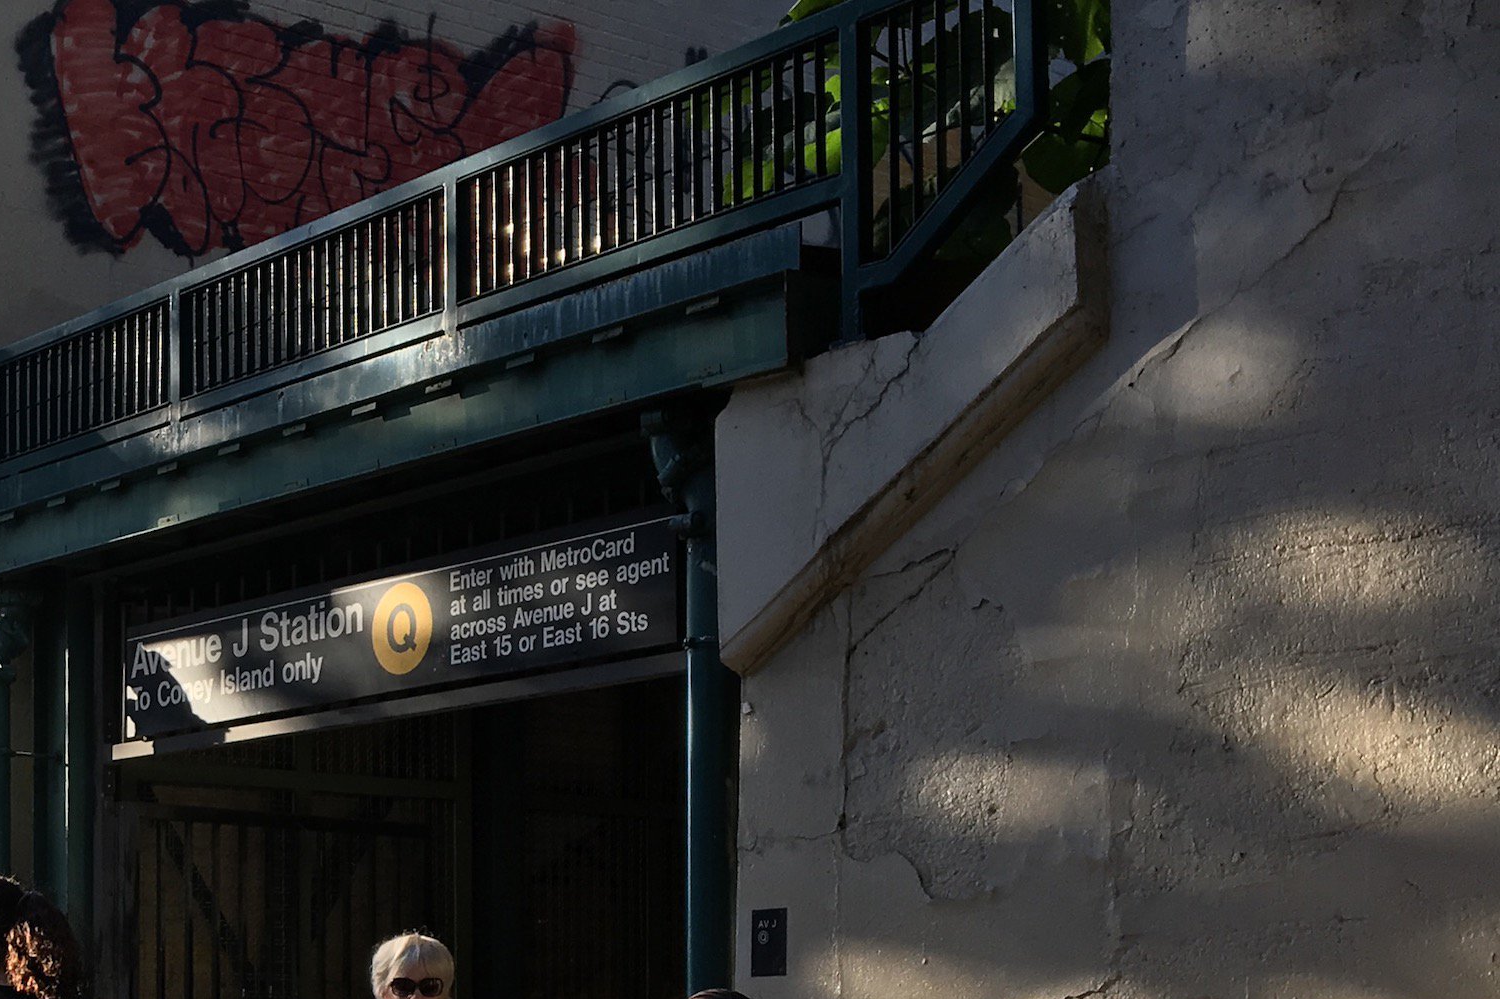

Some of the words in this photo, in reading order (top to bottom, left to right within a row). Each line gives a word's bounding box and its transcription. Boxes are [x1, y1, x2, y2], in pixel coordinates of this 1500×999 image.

[450, 567, 493, 592] Enter
[500, 555, 534, 581] with
[541, 532, 635, 573] MetroCard
[450, 595, 466, 616] at
[473, 589, 491, 612] all
[497, 582, 544, 607] times
[550, 576, 569, 596] or
[575, 568, 610, 591] see
[616, 552, 670, 585] agent
[131, 634, 222, 679] Avenue
[233, 618, 249, 658] J
[260, 601, 364, 652] Station
[387, 604, 417, 653] Q
[450, 615, 507, 641] across
[513, 601, 575, 629] Avenue
[581, 593, 592, 616] J
[599, 589, 617, 612] at
[450, 640, 487, 665] East
[493, 634, 512, 657] 15
[518, 634, 537, 653] or
[543, 621, 582, 648] East
[589, 615, 610, 640] 16
[616, 611, 649, 635] Sts
[133, 687, 151, 712] To
[157, 676, 214, 707] Coney
[220, 659, 275, 696] Island
[282, 652, 323, 684] only
[772, 919, 777, 928] J
